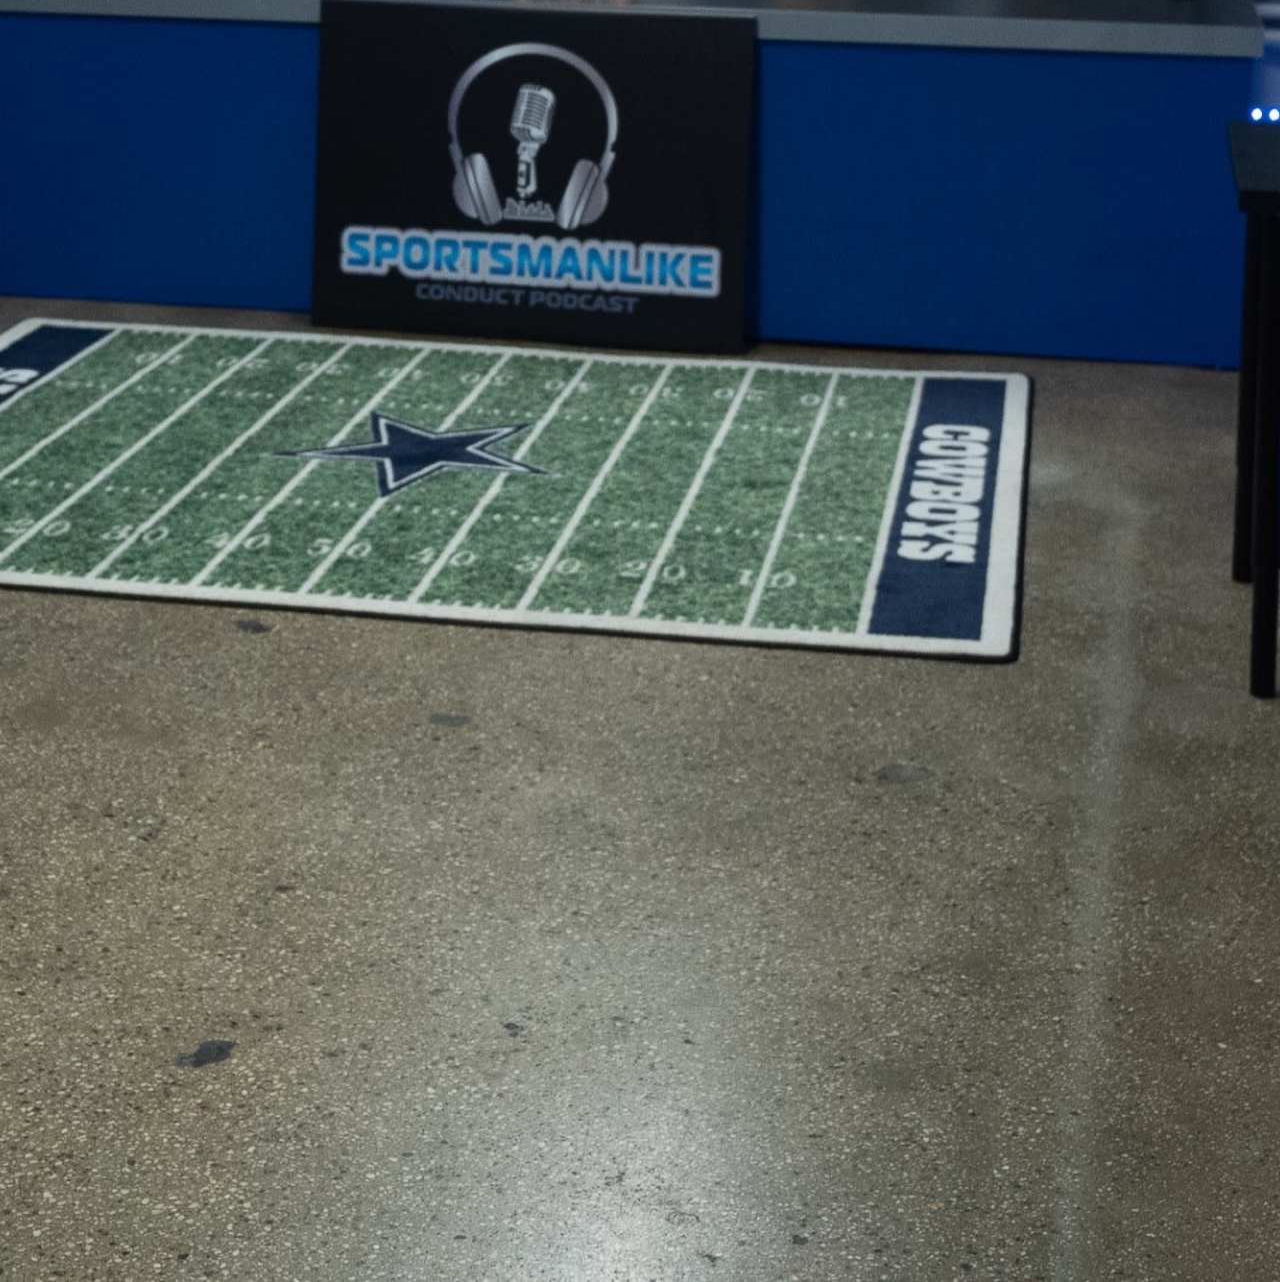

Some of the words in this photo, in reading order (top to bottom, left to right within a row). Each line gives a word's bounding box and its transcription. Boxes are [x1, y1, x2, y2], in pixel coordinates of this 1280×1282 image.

[341, 227, 720, 298] SPORTSMANLIKE
[415, 281, 527, 308] CONDUCT
[529, 290, 640, 314] PODCAST
[897, 424, 991, 564] COWBOYS
